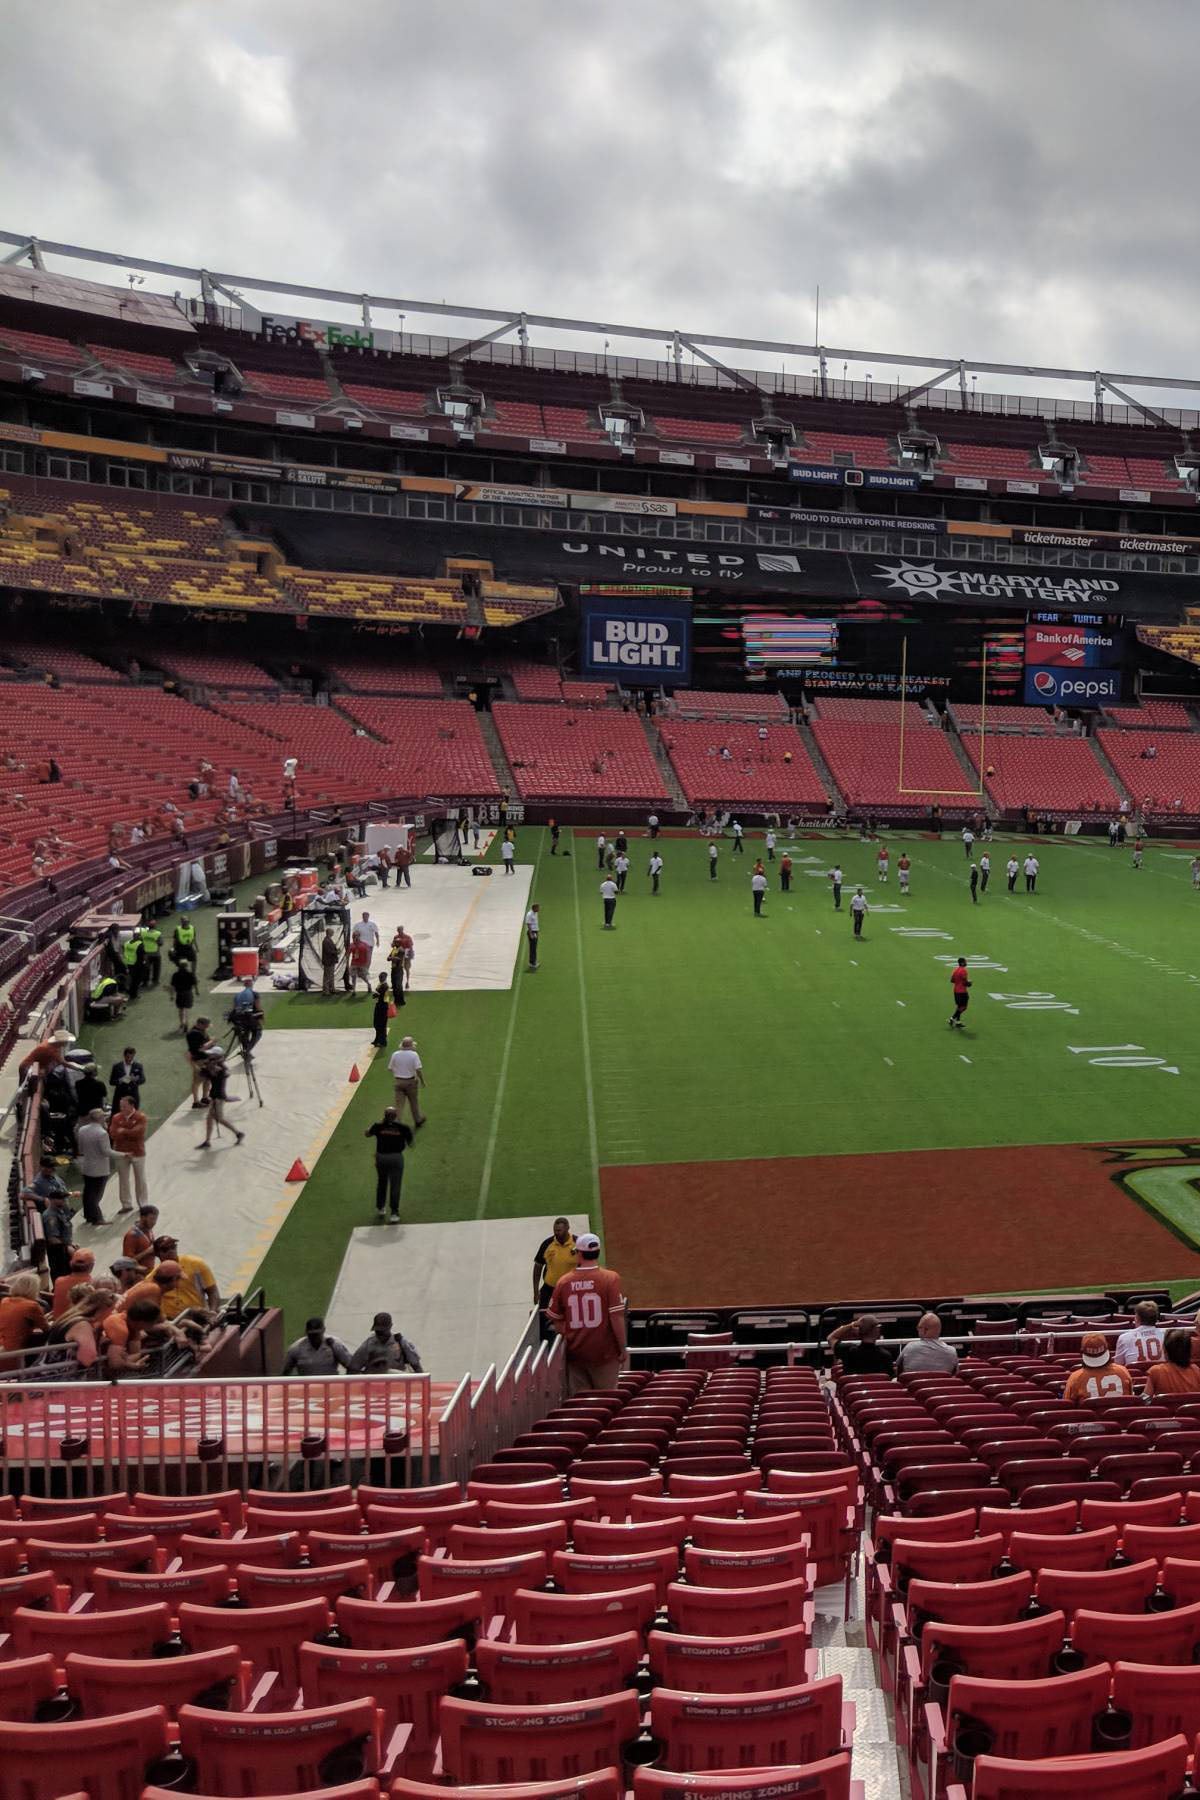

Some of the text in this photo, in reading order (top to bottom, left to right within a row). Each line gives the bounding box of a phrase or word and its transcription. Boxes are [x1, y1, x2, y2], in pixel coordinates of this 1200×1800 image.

[261, 316, 374, 348] FedExField
[793, 468, 839, 480] BUD LIGHT
[869, 475, 916, 487] BUD LIGHT
[650, 503, 668, 513] sas
[790, 512, 818, 522] PROUD
[818, 514, 829, 523] TO
[830, 515, 863, 526] DELIVER
[864, 519, 880, 527] FOR
[881, 519, 896, 528] THE
[1024, 532, 1094, 547] ticketmaster
[1119, 538, 1189, 553] ticketmaster
[562, 542, 745, 566] UNITED
[622, 562, 745, 580] Proud to fly
[959, 571, 1120, 592] MARYLAND
[961, 584, 1094, 603] LOTTERY
[1073, 614, 1103, 624] TURTLE
[605, 620, 669, 644] BUD
[1036, 632, 1113, 647] Bank of America
[593, 642, 681, 667] LIGHT
[859, 673, 874, 681] TO
[877, 674, 897, 683] THE
[1060, 678, 1115, 698] pepsi
[570, 1280, 595, 1291] YOUNG
[567, 1292, 603, 1330] 10
[1135, 1337, 1163, 1361] 10
[681, 1643, 766, 1657] STOMPING ZONE!
[548, 1711, 586, 1725] ZONE!
[757, 1781, 801, 1798] ZONE!
